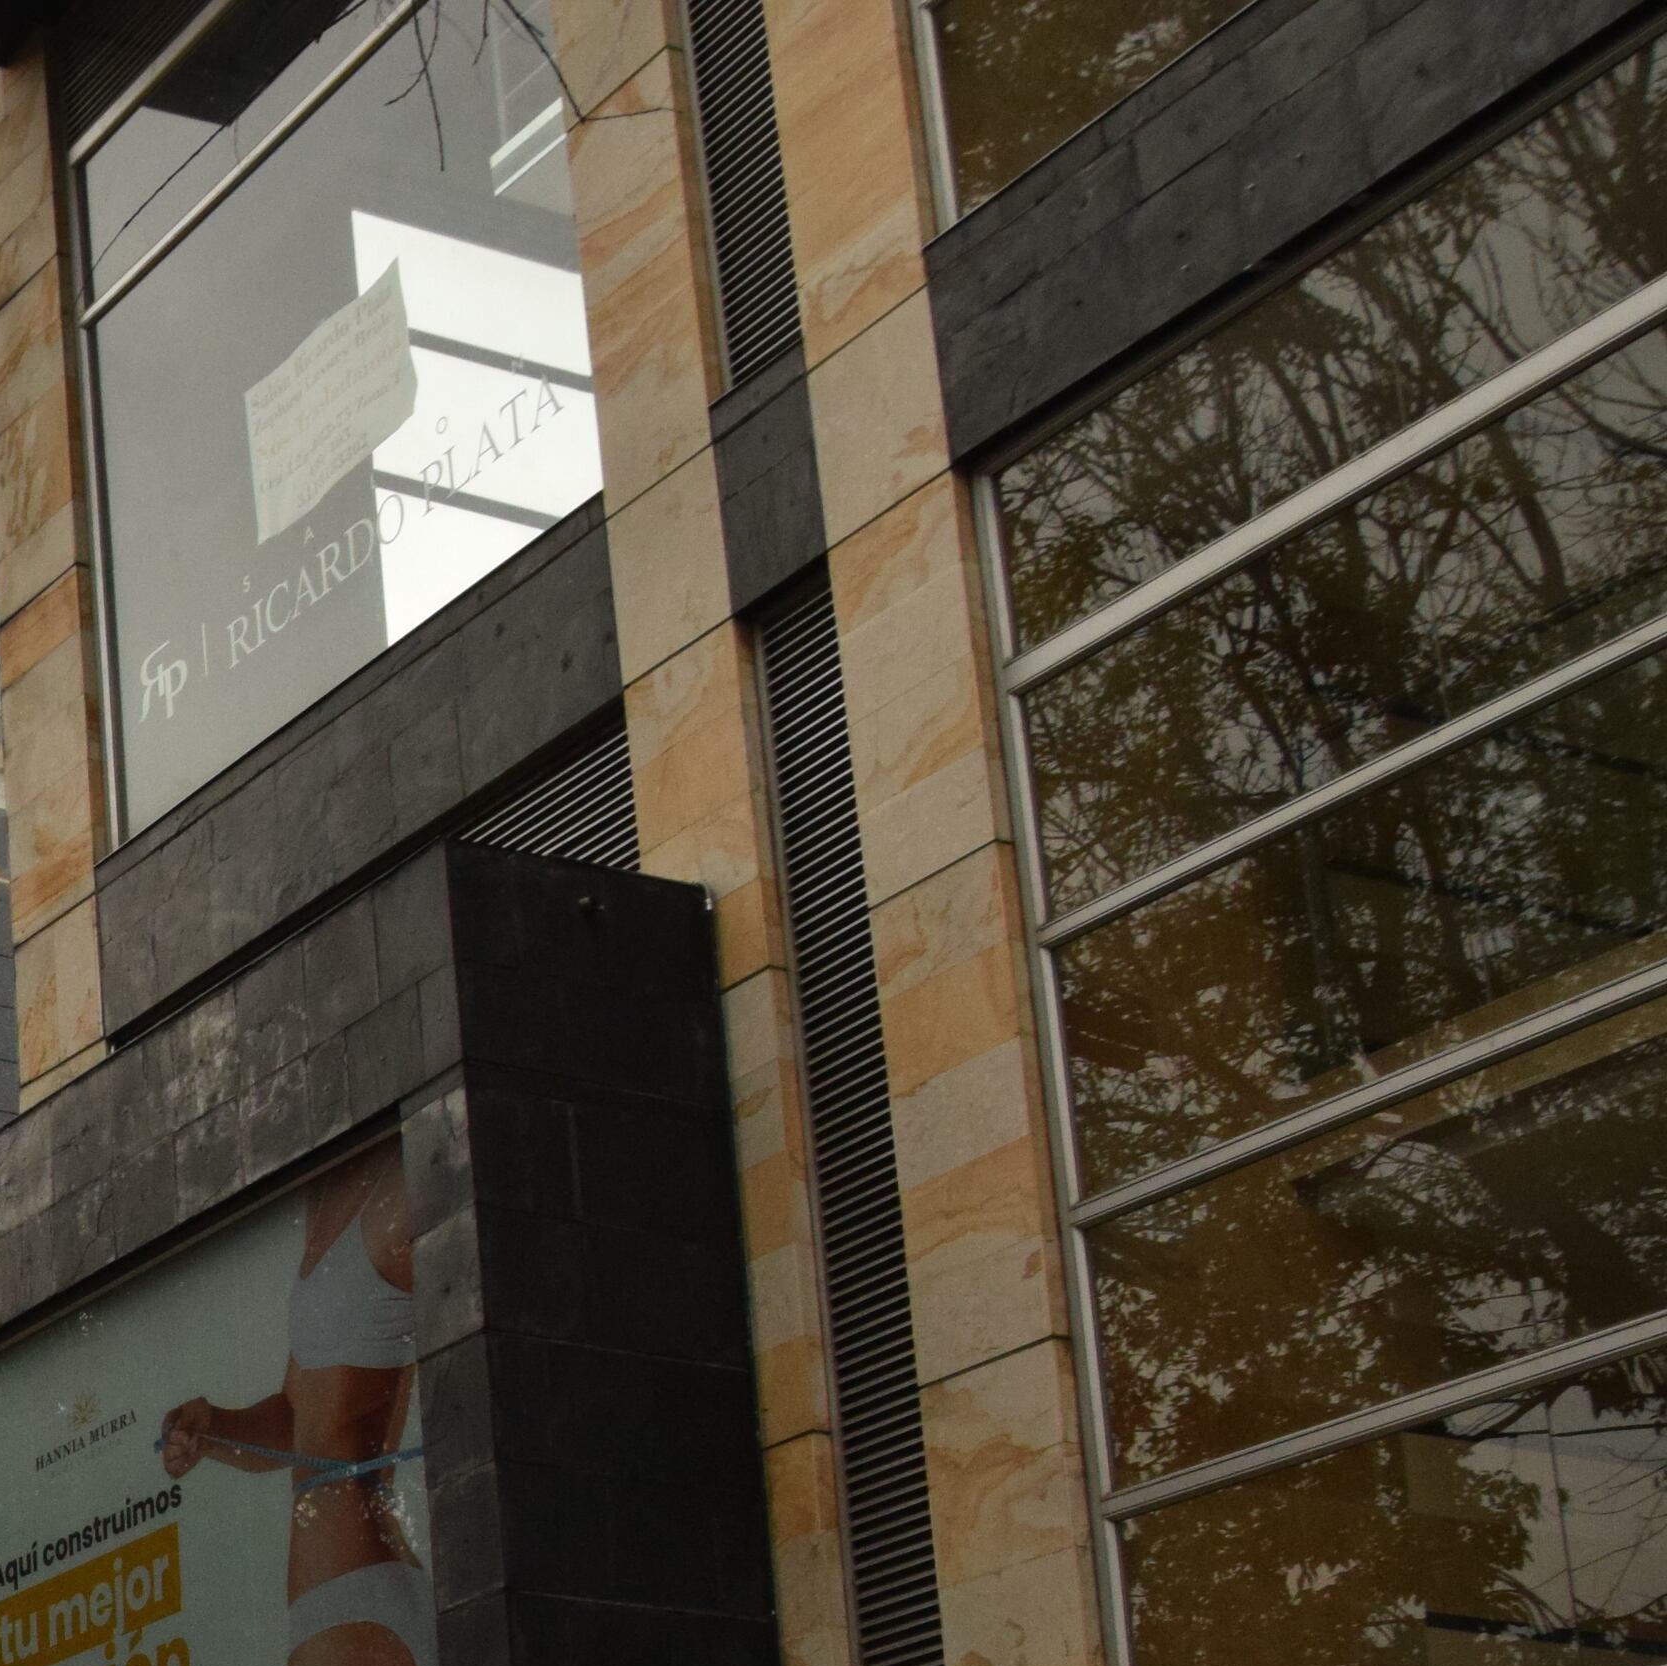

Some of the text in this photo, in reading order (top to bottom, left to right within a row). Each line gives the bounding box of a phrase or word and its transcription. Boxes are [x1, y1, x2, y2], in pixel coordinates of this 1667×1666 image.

[226, 494, 404, 669] RICARDO
[419, 374, 565, 517] PLATA
[35, 1436, 85, 1471] HANNIA
[89, 1409, 137, 1445] MURRA
[42, 1484, 182, 1567] construimos
[48, 1556, 170, 1648] mejor
